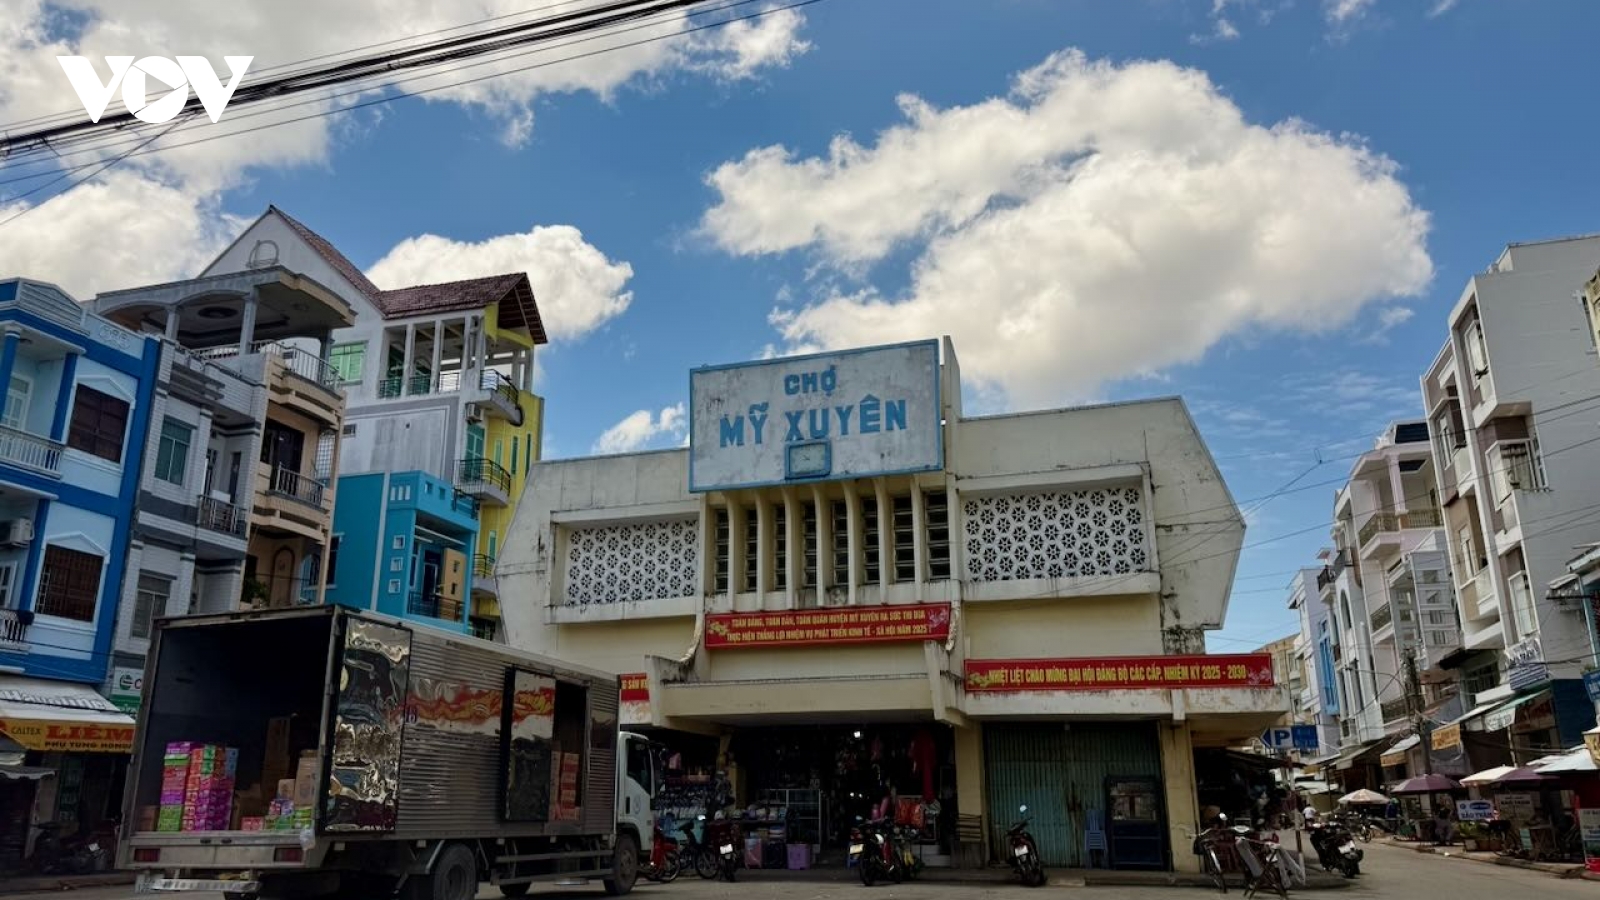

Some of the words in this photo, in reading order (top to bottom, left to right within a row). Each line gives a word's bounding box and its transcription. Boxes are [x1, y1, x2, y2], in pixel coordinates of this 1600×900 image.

[784, 364, 838, 397] CHỢ
[719, 401, 769, 448] MỸ
[785, 394, 907, 442] XUYÊN
[988, 666, 1009, 687] NHIỆT
[1009, 666, 1024, 686] LIỆT
[1025, 665, 1045, 683] CHÀO
[1045, 665, 1067, 683] MỪNG
[1068, 668, 1081, 685] ĐẠI
[1082, 664, 1095, 685] HỘI
[1096, 663, 1117, 682] ĐẢNG
[1118, 664, 1128, 684] BỘ
[1129, 663, 1145, 681] CÁC
[1164, 663, 1189, 683] NHIỆM
[1201, 665, 1221, 680] 2025
[1227, 664, 1247, 680] 2030
[11, 726, 41, 736] CALTEX
[1274, 730, 1290, 745] P
